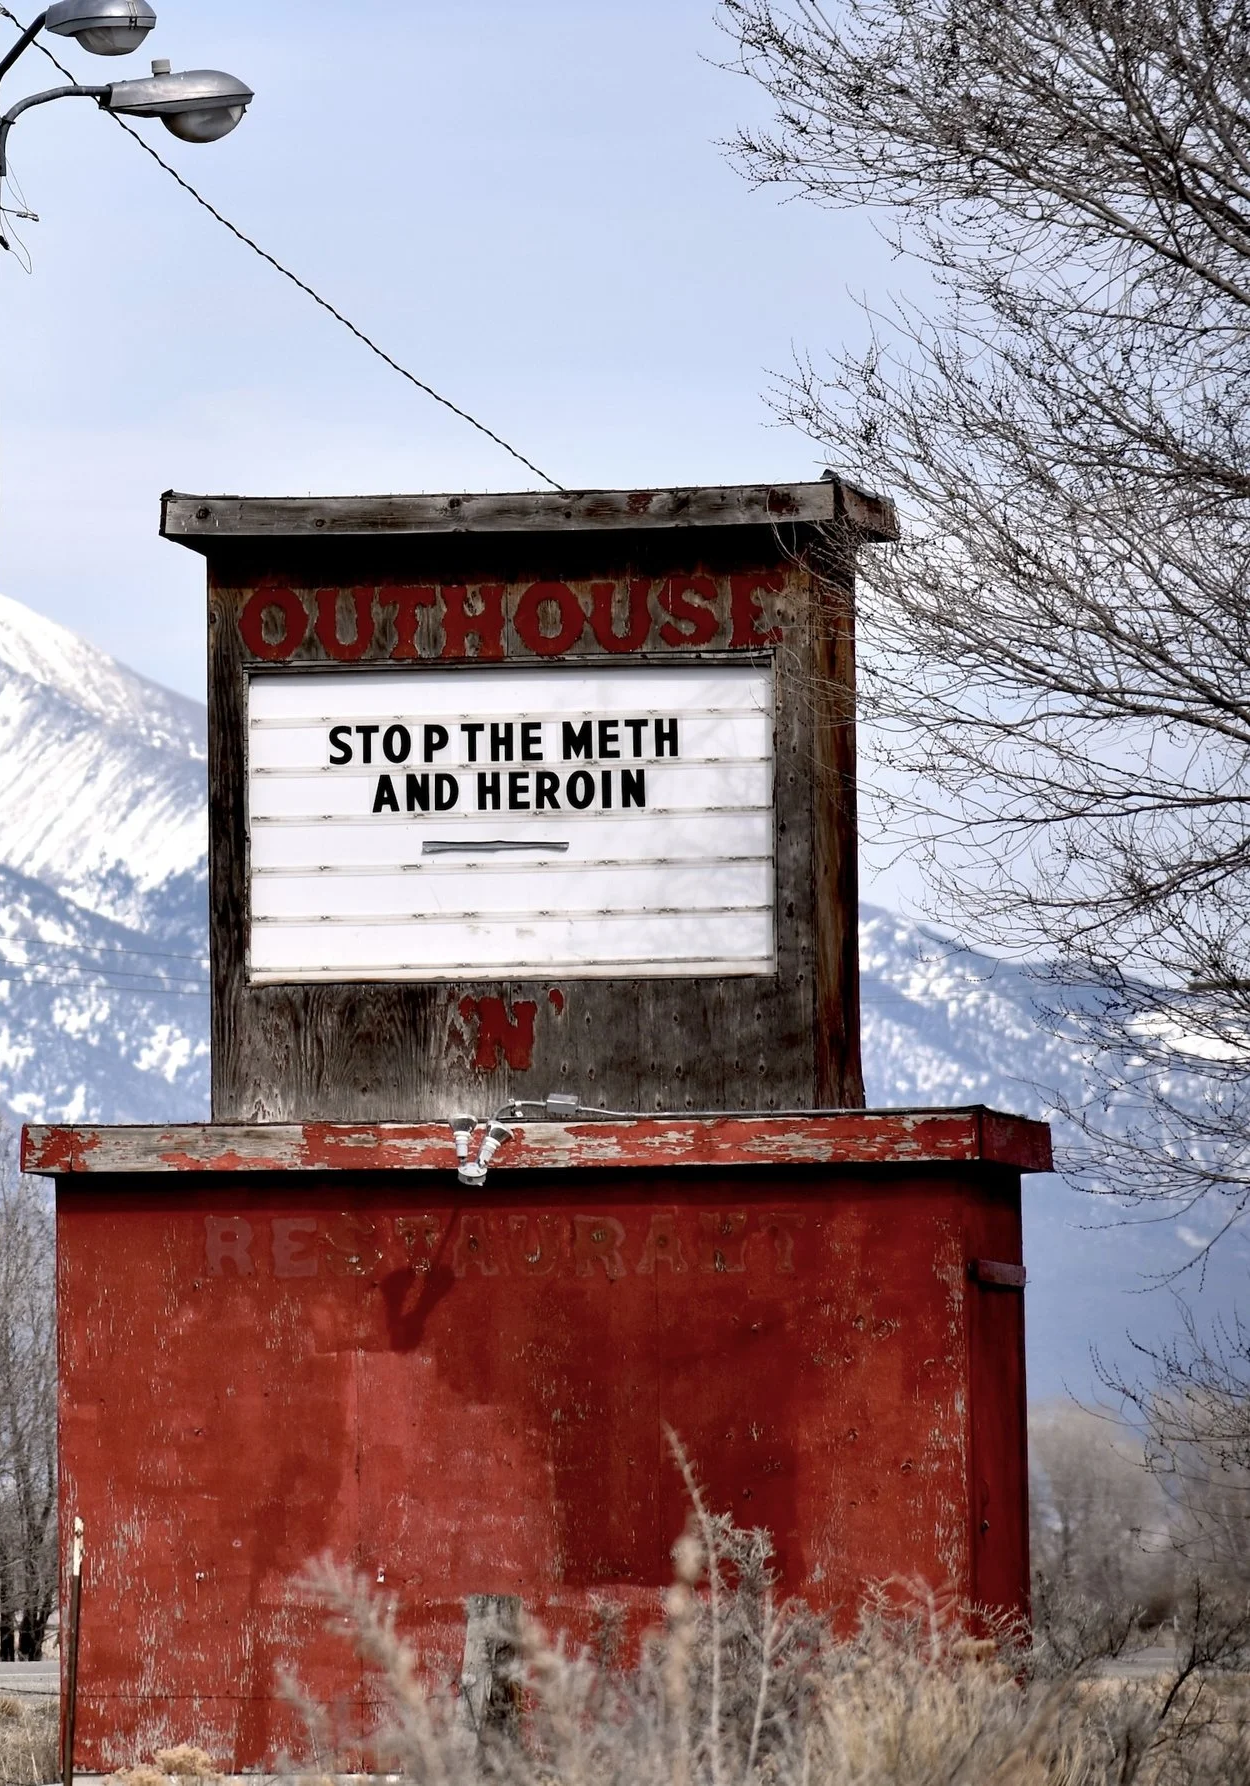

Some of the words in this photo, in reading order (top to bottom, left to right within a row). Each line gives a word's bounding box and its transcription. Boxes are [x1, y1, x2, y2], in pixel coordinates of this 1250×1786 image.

[238, 572, 785, 661] OUTHOUSE
[329, 725, 448, 764] STOP
[461, 722, 543, 761] THE
[562, 718, 678, 759] METH
[373, 774, 458, 812] AND
[478, 769, 645, 810] HEROIN
